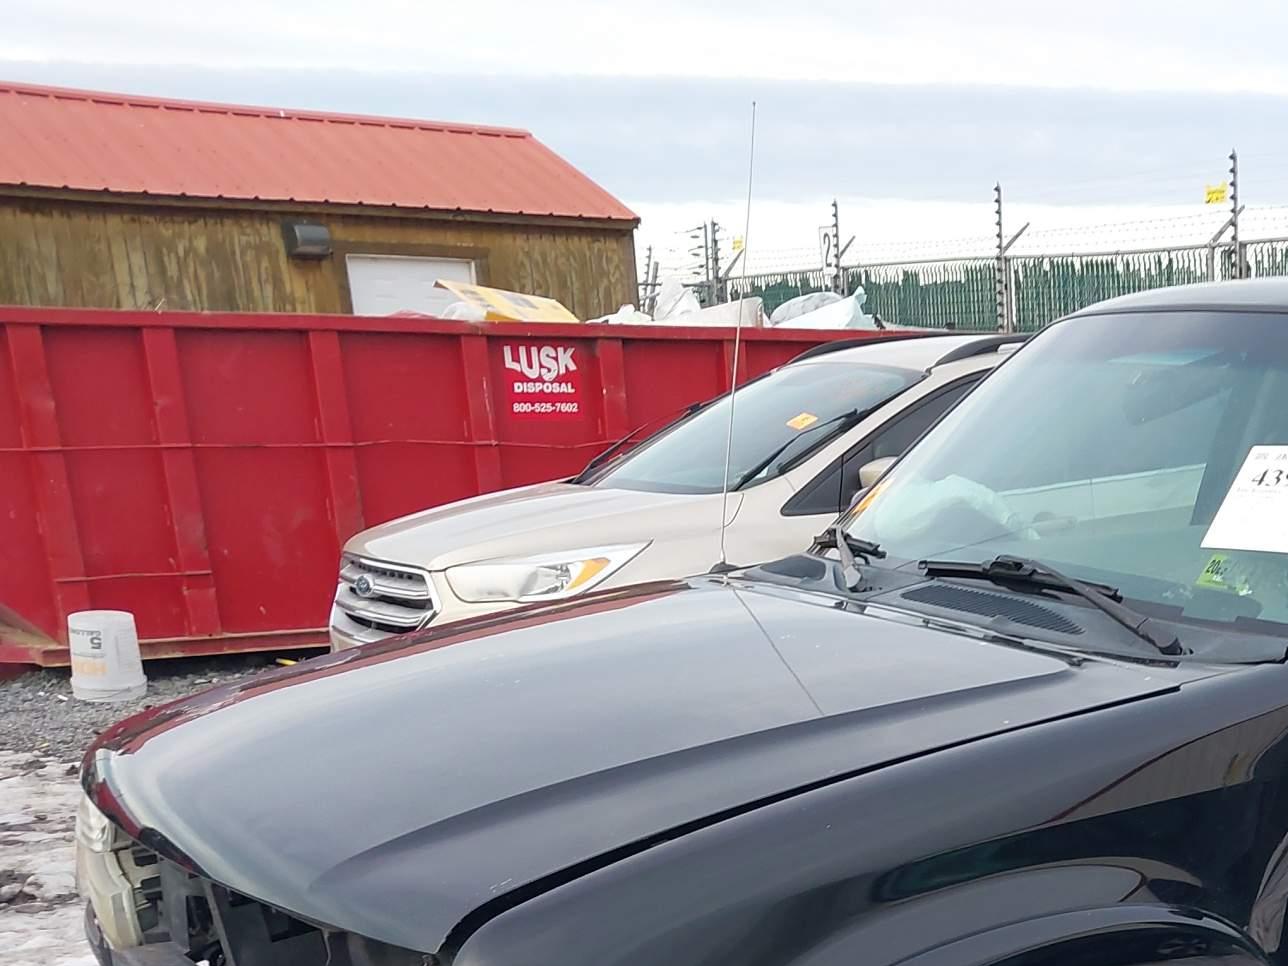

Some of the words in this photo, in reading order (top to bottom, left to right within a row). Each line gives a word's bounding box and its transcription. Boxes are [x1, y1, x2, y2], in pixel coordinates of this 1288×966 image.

[822, 232, 832, 267] 2
[503, 345, 578, 381] LUSK
[513, 382, 576, 394] DISPOSAL
[512, 402, 579, 413] 800-525-7602
[89, 636, 102, 650] 5
